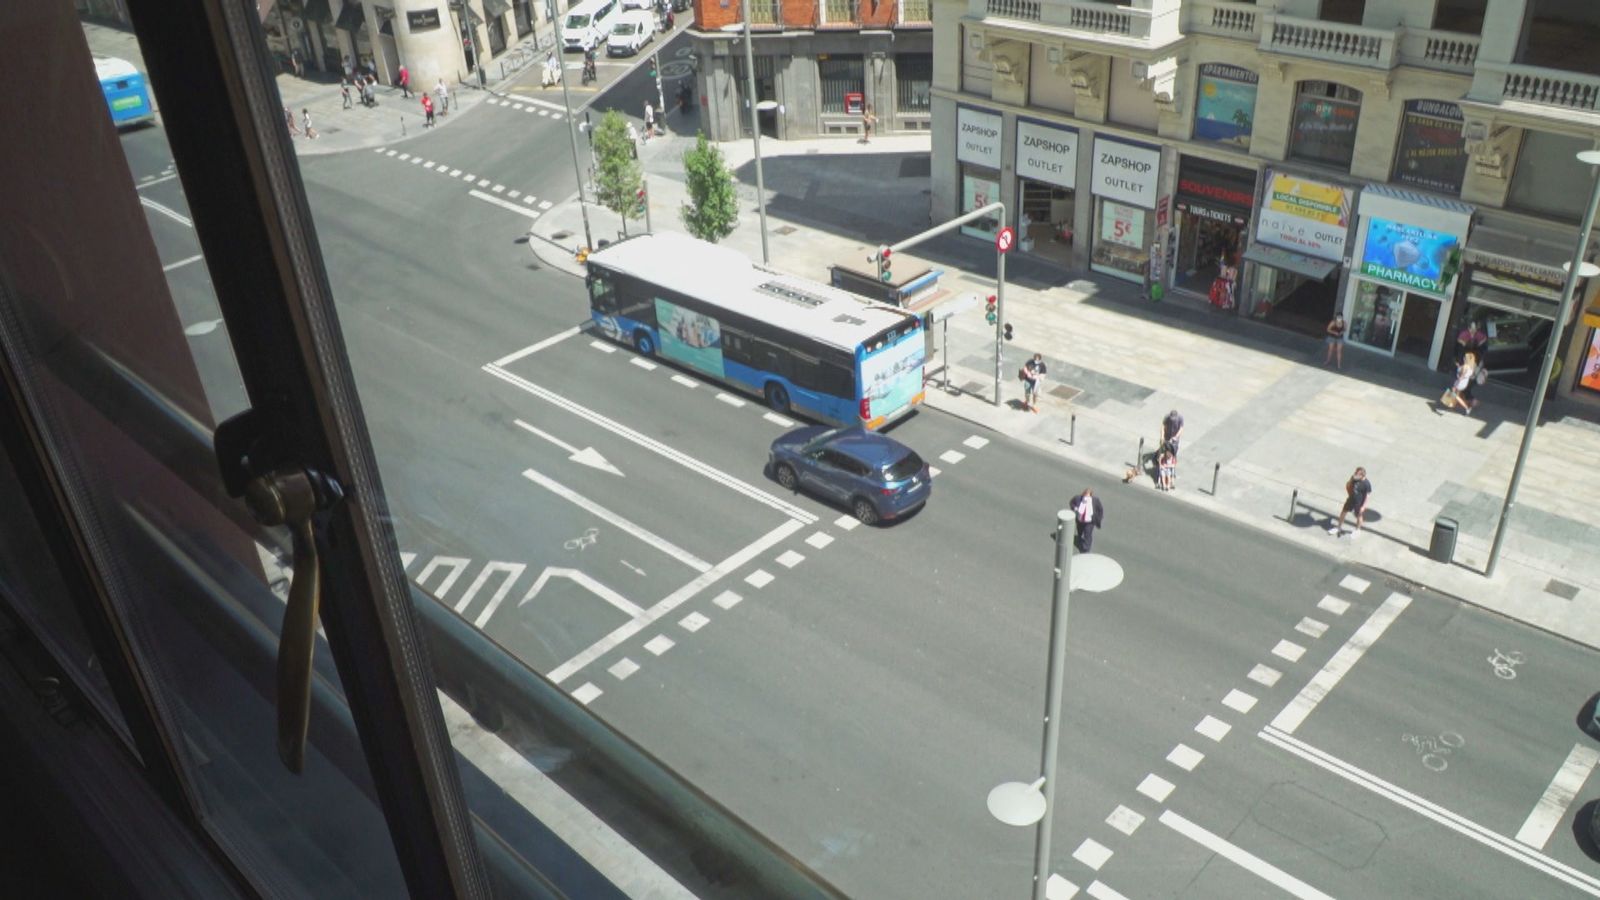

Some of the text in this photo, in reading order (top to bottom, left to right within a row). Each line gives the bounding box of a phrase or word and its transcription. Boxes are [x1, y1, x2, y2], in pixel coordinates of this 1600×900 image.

[1203, 64, 1257, 82] APARTAMENTOS
[961, 123, 998, 139] ZAPSHOP
[965, 142, 993, 155] OUTLET
[1023, 135, 1070, 154] ZAPSHOP
[1027, 157, 1063, 173] OUTLET
[1100, 153, 1151, 173] ZAPSHOP
[1104, 176, 1144, 193] OUTLET
[1276, 193, 1297, 205] LOCAL
[1298, 198, 1338, 213] DISPONIBLE
[1210, 209, 1231, 223] TICKETS
[1113, 218, 1132, 238] 5€
[1314, 231, 1344, 245] OUTLET
[1367, 264, 1437, 291] PHARMACY
